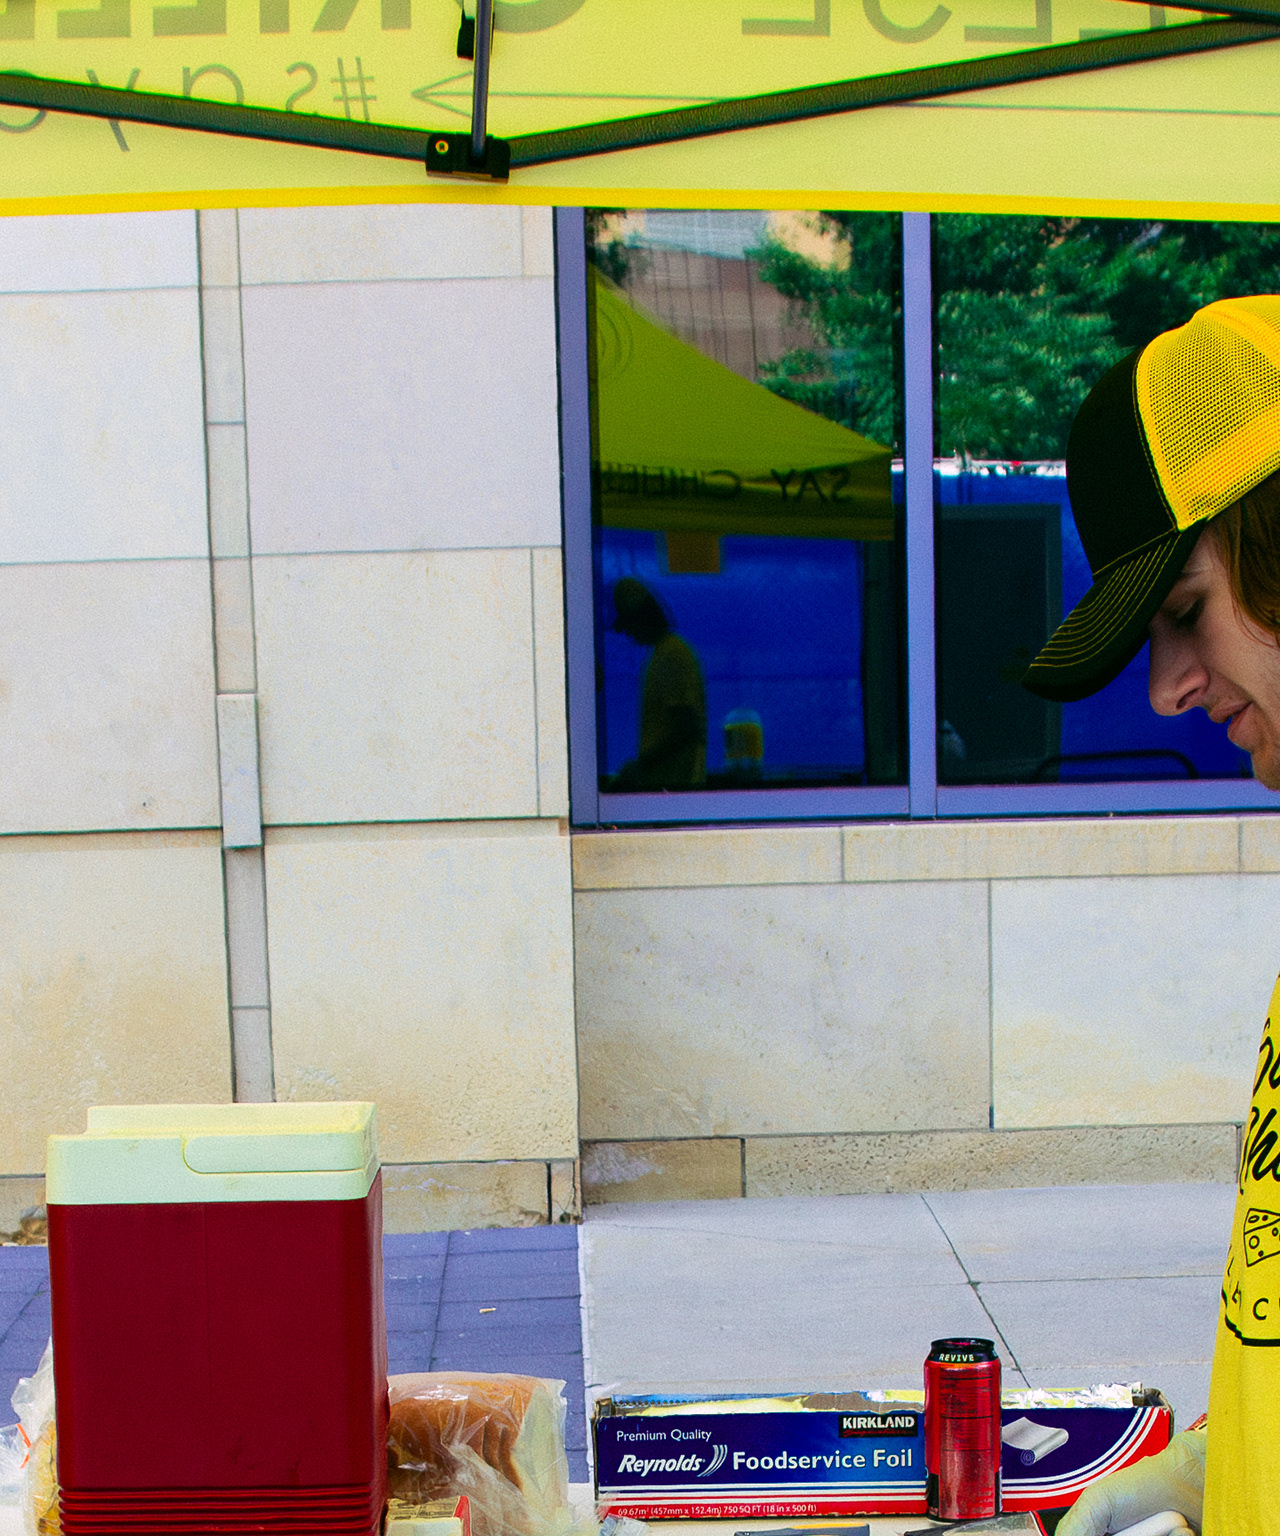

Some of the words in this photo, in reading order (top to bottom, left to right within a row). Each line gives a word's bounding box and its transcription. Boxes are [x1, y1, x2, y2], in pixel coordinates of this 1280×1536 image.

[938, 1353, 975, 1362] REVIVE
[842, 1416, 916, 1429] KIRKLAND
[616, 1430, 667, 1443] Premium
[670, 1428, 712, 1443] Quality
[617, 1453, 704, 1477] Reynolds
[732, 1449, 866, 1470] Foodservice
[873, 1448, 913, 1468] Foil
[650, 1505, 684, 1516] (457mm
[723, 1505, 738, 1514] 750
[739, 1505, 751, 1514] SQ
[752, 1504, 761, 1513] FT
[762, 1504, 776, 1514] (18
[792, 1504, 807, 1513] 500
